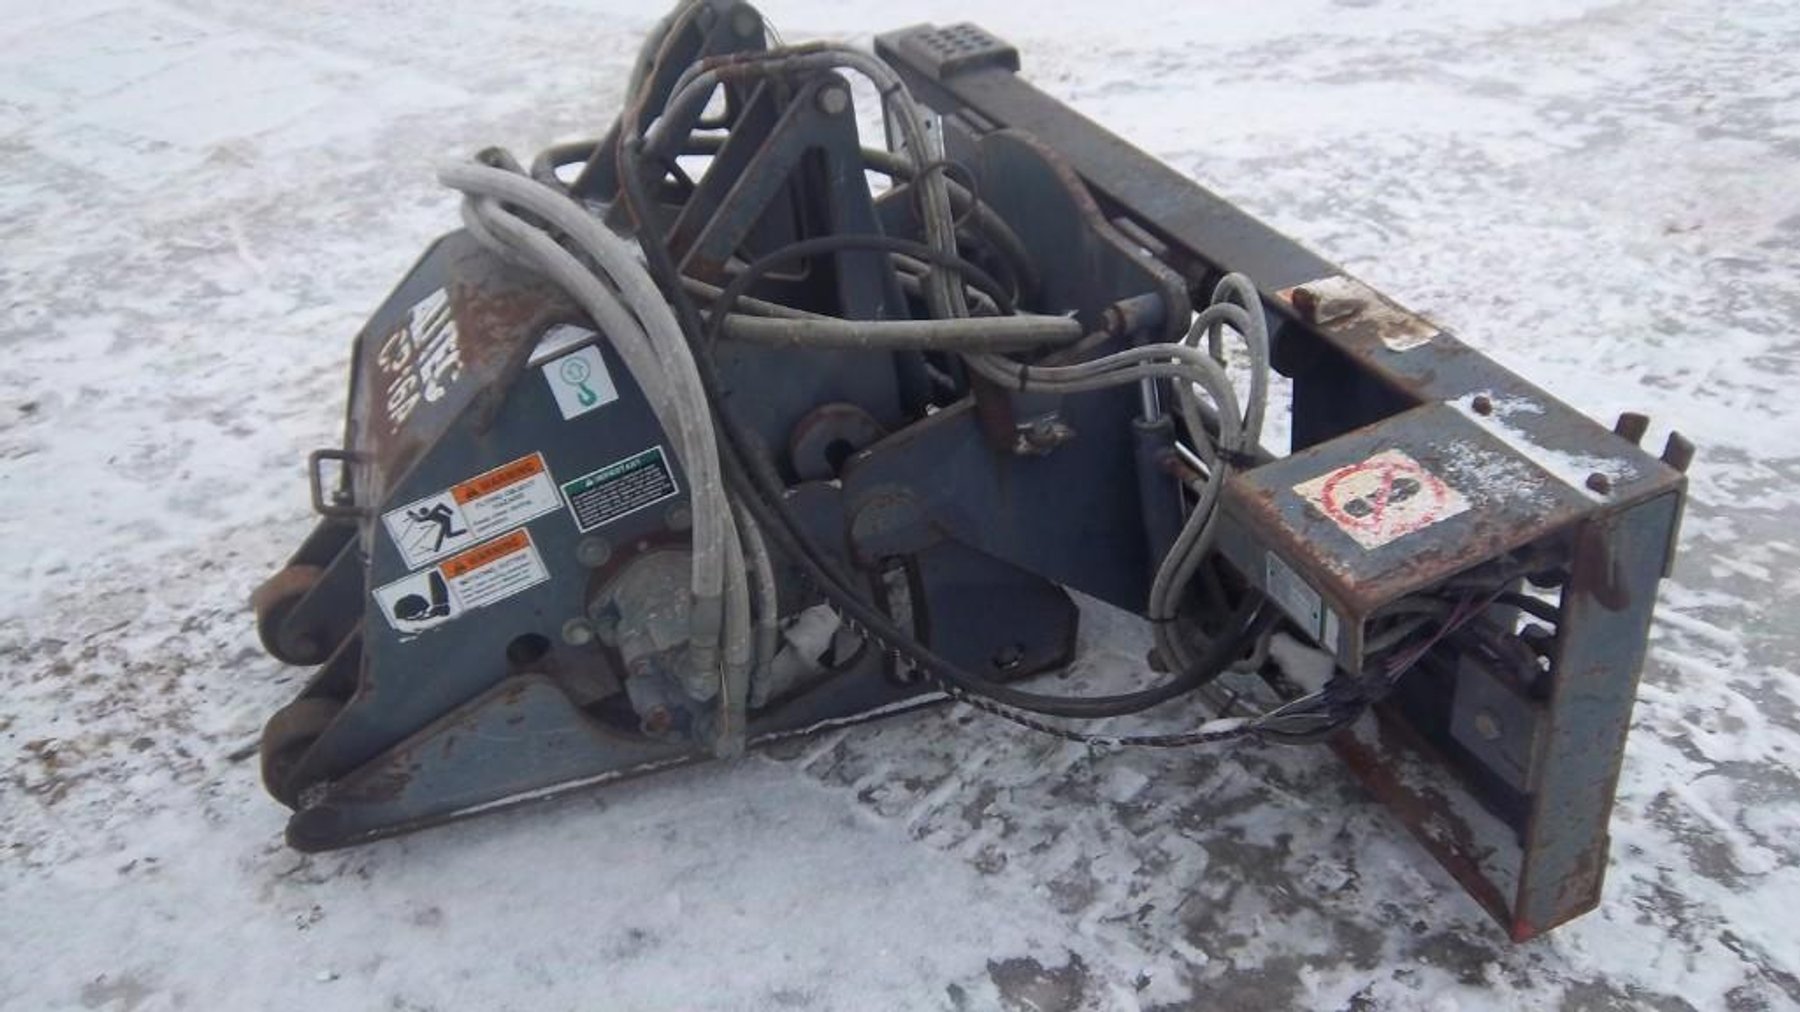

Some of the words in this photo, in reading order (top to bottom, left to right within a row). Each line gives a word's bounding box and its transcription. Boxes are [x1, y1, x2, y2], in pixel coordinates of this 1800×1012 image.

[475, 458, 537, 492] WARNING
[593, 458, 642, 483] IMPORTANT
[463, 534, 525, 567] WARNING
